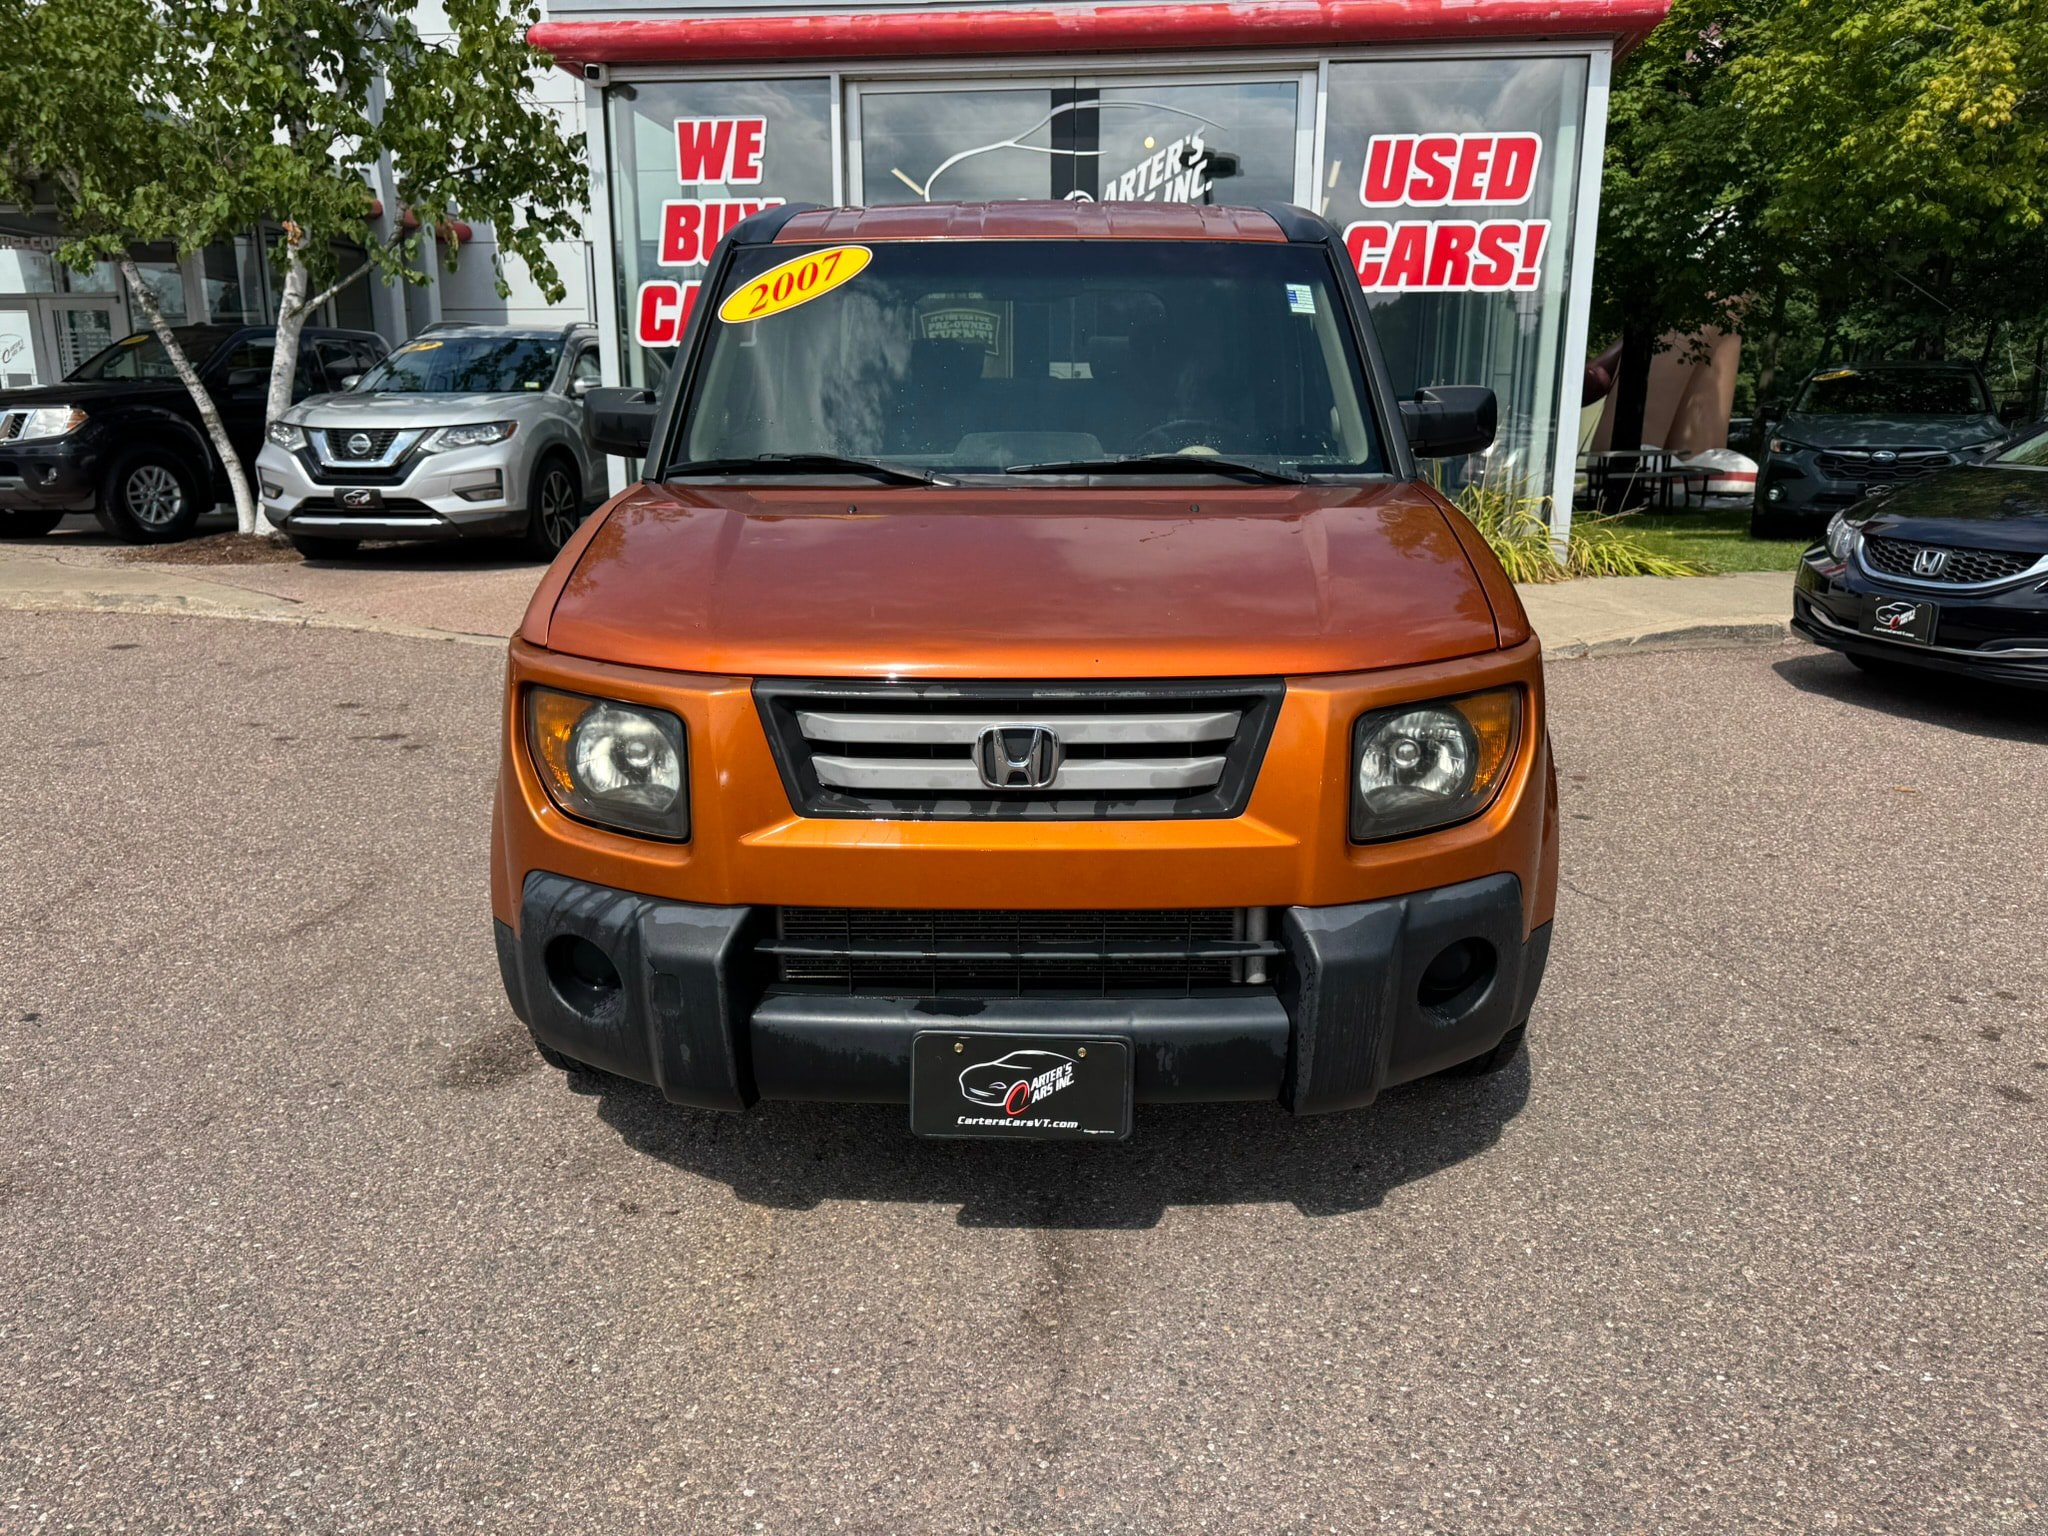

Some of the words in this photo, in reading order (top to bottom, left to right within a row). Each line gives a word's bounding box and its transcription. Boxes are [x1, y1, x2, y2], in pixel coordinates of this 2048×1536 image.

[676, 118, 764, 183] WE
[1163, 159, 1213, 203] INC.
[1362, 136, 1539, 203] USED
[661, 201, 783, 263] BU
[1345, 223, 1548, 287] CARS!
[748, 251, 842, 315] 2007
[957, 1116, 1078, 1129] CartersCarsVT.com
